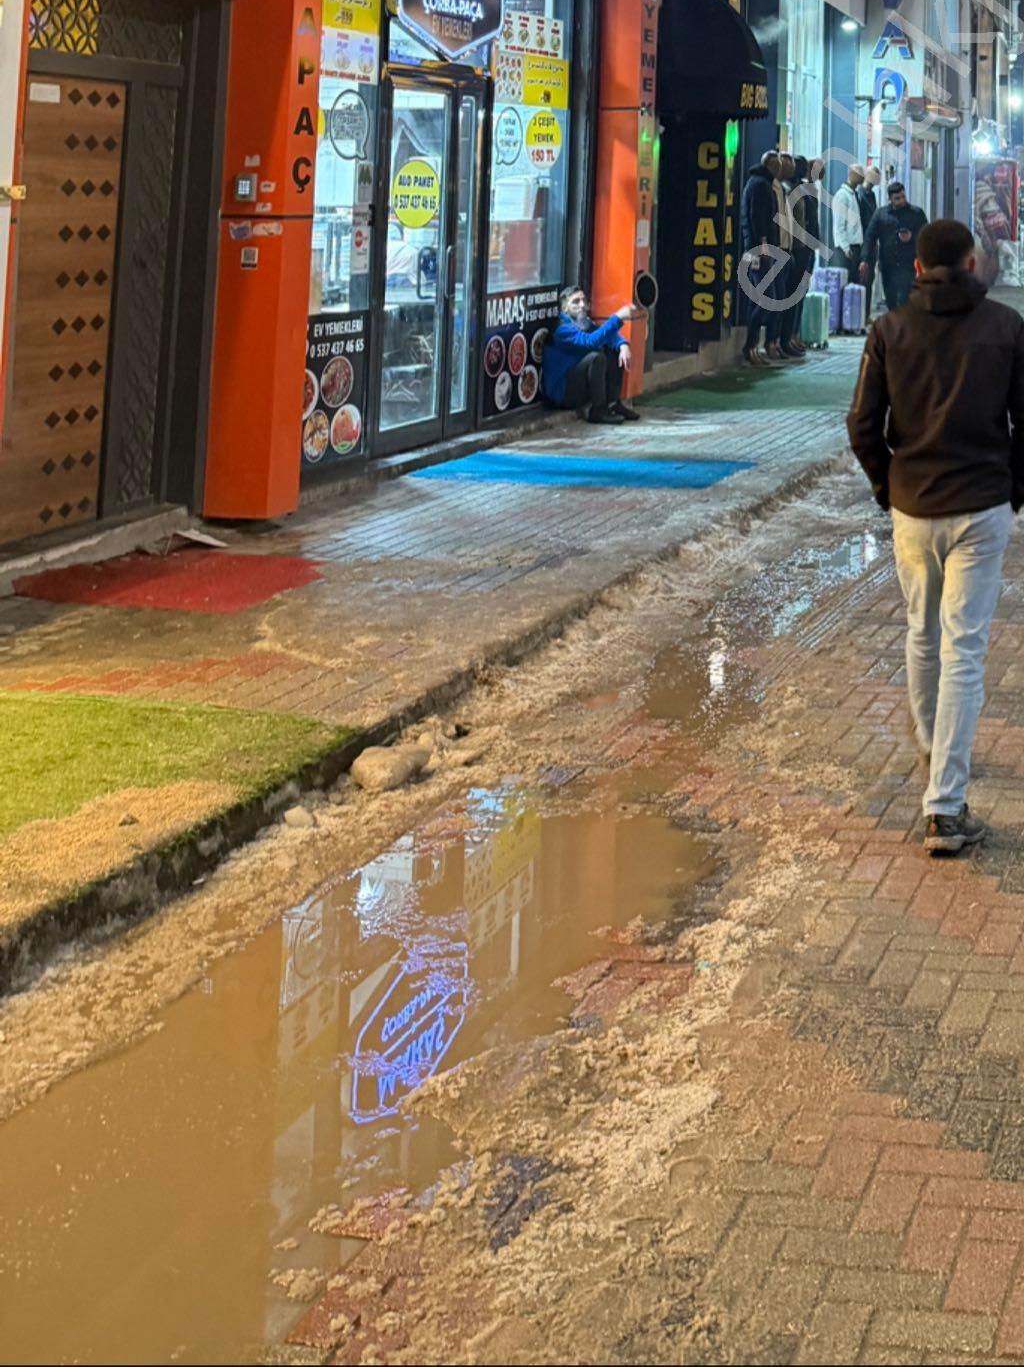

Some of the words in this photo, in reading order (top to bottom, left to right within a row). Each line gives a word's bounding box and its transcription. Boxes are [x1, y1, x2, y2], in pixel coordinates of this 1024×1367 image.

[533, 133, 554, 143] YEMEK
[546, 148, 555, 162] TL
[413, 175, 434, 188] PAKET
[692, 140, 720, 324] CLASS
[486, 294, 525, 330] MARAŞ
[313, 324, 325, 337] EV
[326, 316, 364, 336] YEMEKLERİ
[316, 343, 330, 358] 537
[330, 341, 344, 356] 437
